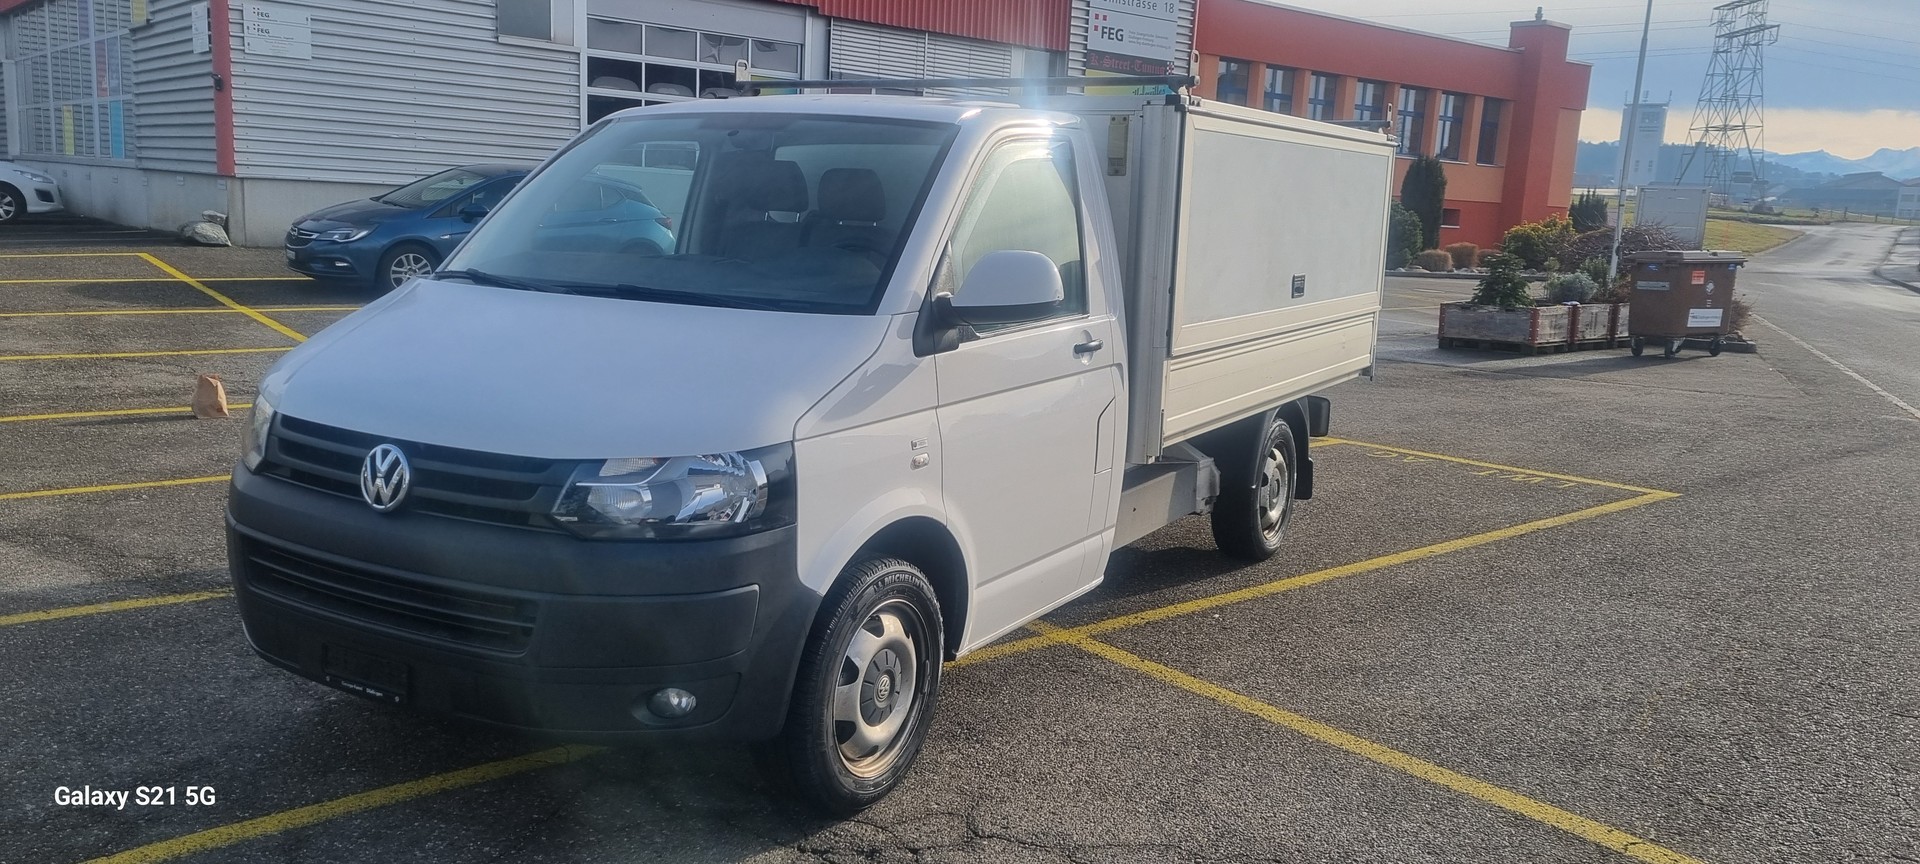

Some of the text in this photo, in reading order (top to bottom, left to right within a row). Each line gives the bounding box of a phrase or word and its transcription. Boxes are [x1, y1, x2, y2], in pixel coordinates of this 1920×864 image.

[1164, 2, 1175, 13] 18
[1101, 26, 1124, 42] FEG
[884, 573, 923, 588] MICHELIN
